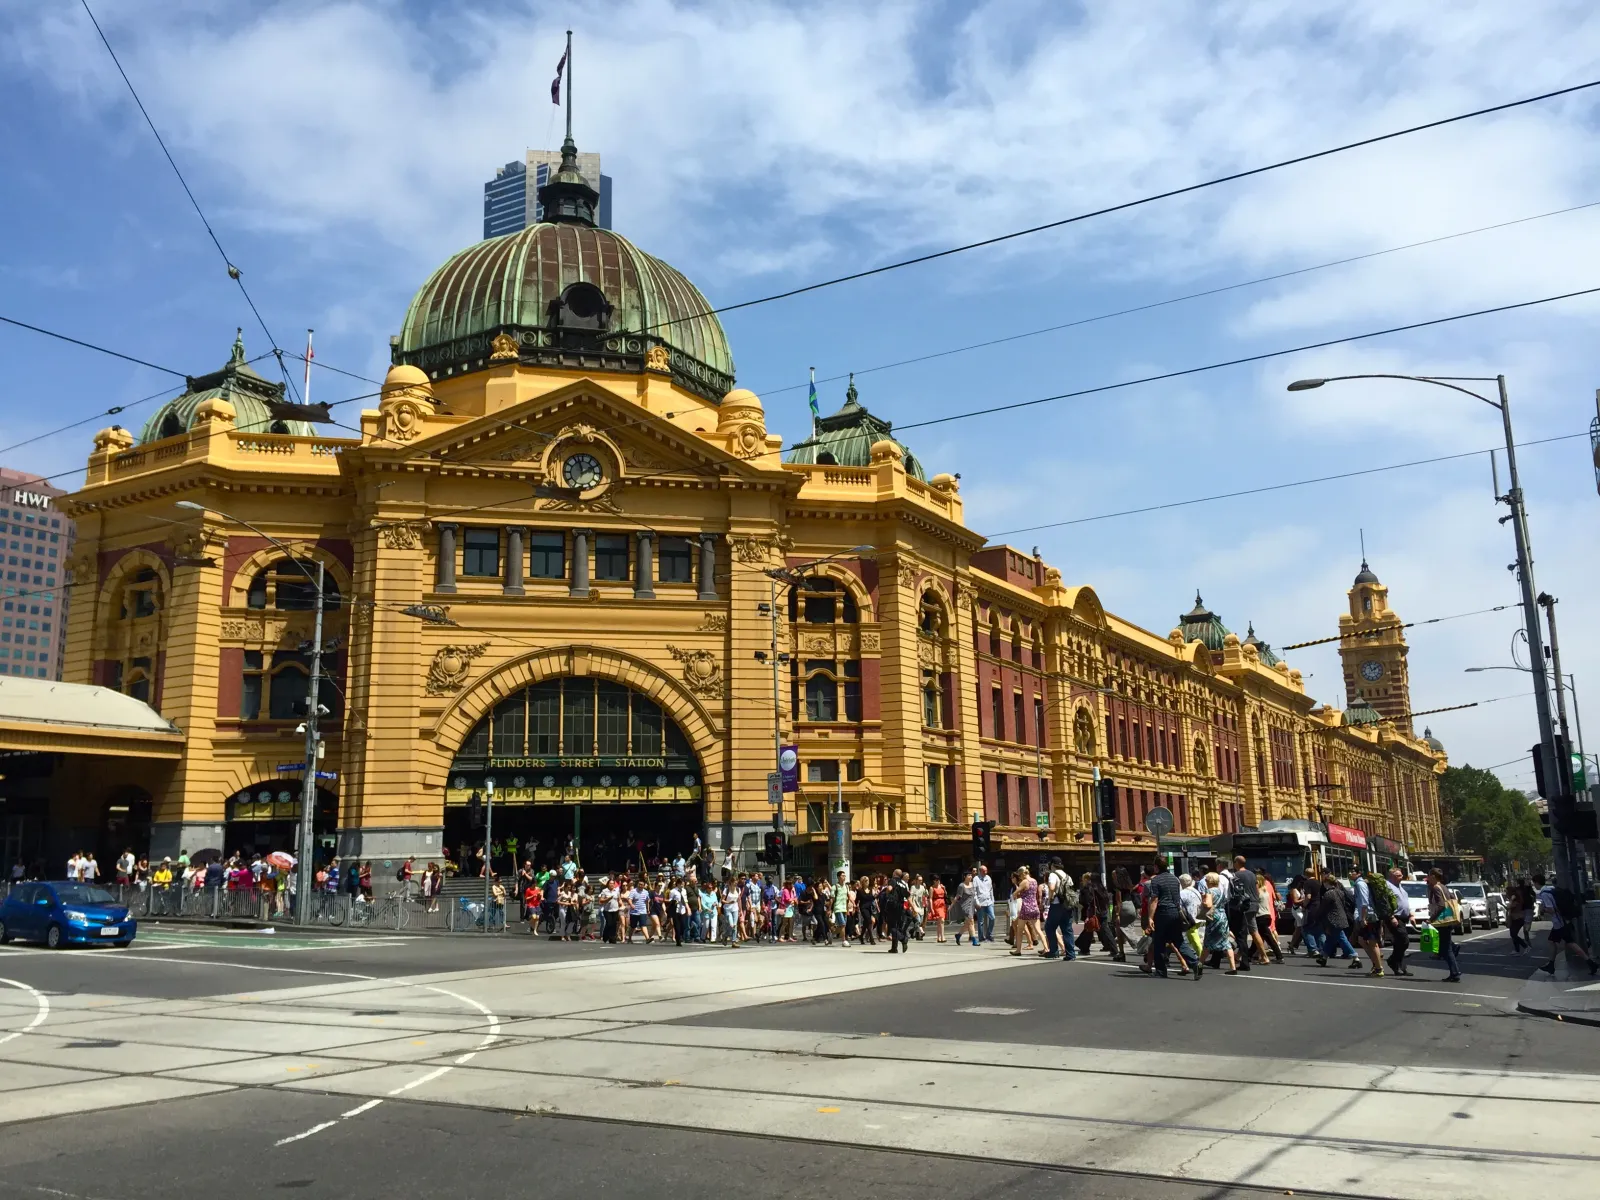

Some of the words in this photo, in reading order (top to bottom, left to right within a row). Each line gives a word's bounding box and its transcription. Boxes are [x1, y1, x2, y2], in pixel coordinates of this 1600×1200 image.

[14, 490, 52, 509] HWT
[490, 758, 546, 768] FLINDERS
[560, 758, 602, 768] STREET
[615, 758, 665, 768] STATION
